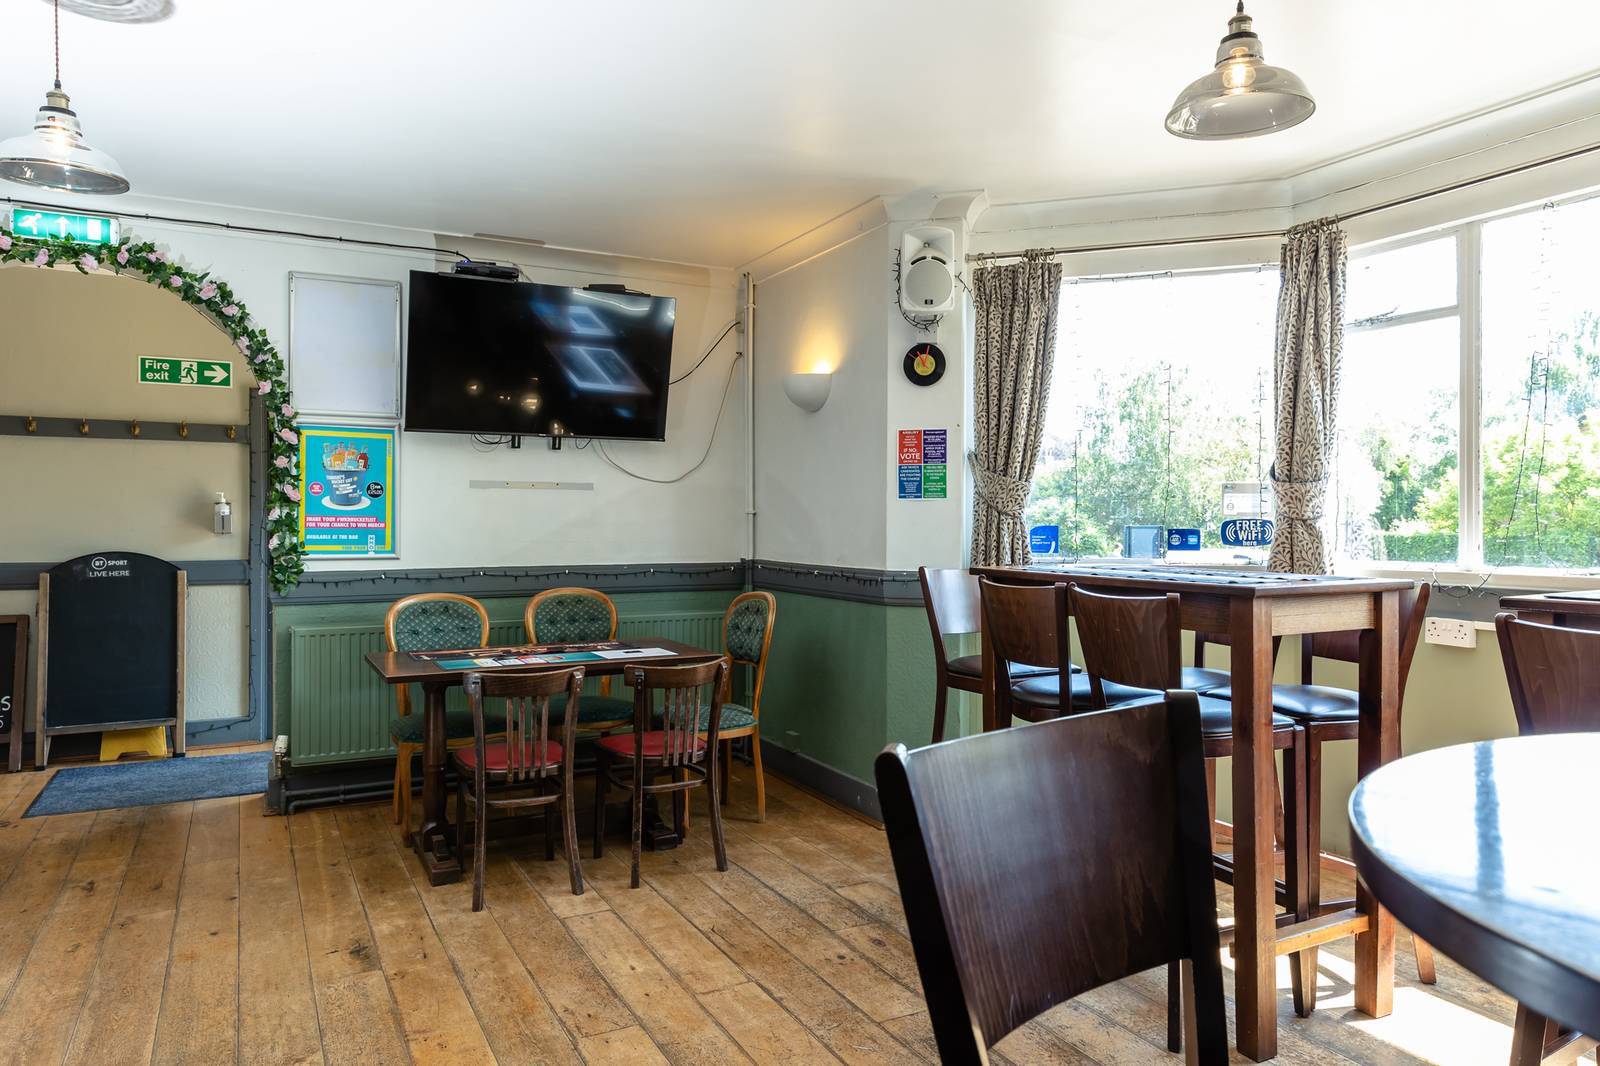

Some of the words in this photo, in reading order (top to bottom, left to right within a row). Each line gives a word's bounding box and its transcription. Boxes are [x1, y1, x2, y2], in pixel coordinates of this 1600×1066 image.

[145, 360, 170, 370] Fire
[146, 371, 169, 380] exit
[900, 452, 920, 460] VOTE
[1236, 520, 1263, 530] FREE
[1238, 529, 1262, 540] WiFi
